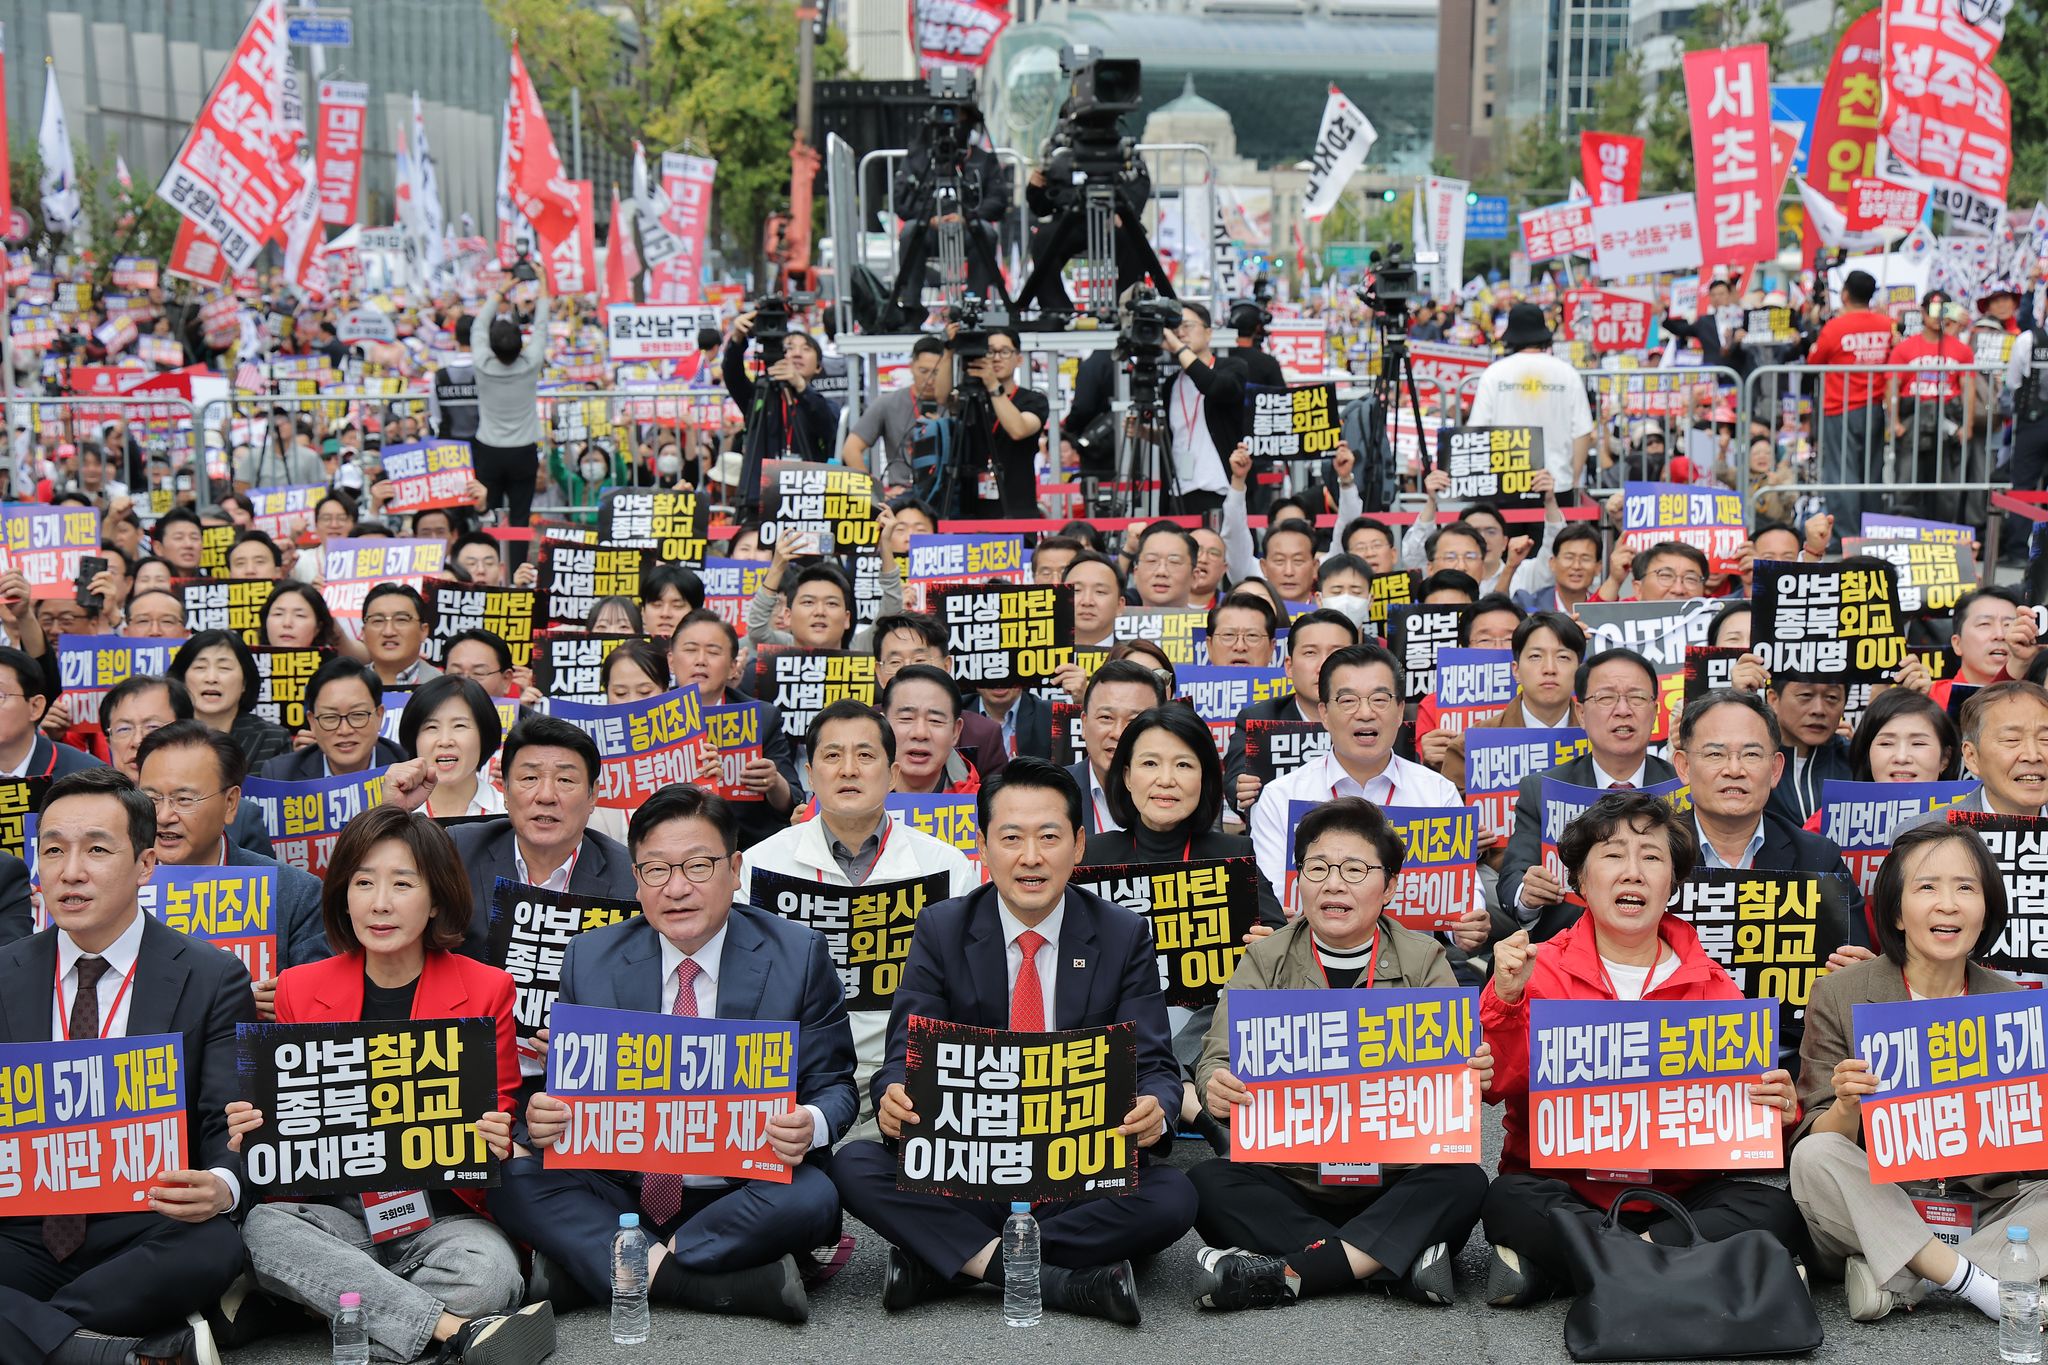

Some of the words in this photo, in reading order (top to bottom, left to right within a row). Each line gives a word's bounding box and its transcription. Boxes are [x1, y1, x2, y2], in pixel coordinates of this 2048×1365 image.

[1706, 61, 1762, 250] 서초갑
[1254, 387, 1329, 415] 안보참사
[1243, 434, 1299, 457] 이재명
[1303, 429, 1342, 454] OUT
[1253, 412, 1330, 437] 종북외교
[1450, 428, 1531, 453] 안보참사
[1450, 451, 1531, 476] 종북외교
[778, 470, 873, 496] 민생파탄
[612, 494, 697, 517] 안보참사
[775, 495, 872, 521] 사법파괴
[1625, 495, 1656, 528] 12개
[1657, 497, 1688, 526] 혐의
[1689, 499, 1715, 525] 5개
[1715, 500, 1744, 526] 재판
[31, 516, 61, 549] 5개
[63, 512, 97, 546] 재판
[611, 516, 693, 539] 종북외교
[836, 521, 880, 545] OUT
[326, 550, 354, 580] 12개
[357, 548, 385, 579] 혐의
[386, 547, 409, 575] 5개
[411, 544, 442, 574] 재판
[553, 548, 642, 575] 민생파탄
[661, 538, 708, 561] OUT
[911, 544, 964, 577] 제멋대로
[966, 539, 1022, 572] 농지조사
[20, 555, 59, 587] 재판
[550, 572, 641, 598] 사법파괴
[1776, 569, 1890, 607] 안보참사
[183, 580, 275, 611] 민생파탄
[436, 588, 536, 617] 민생파탄
[945, 589, 1058, 624] 민생파탄
[947, 617, 1056, 653] 사법파괴
[1405, 613, 1459, 641] 안보
[1774, 602, 1896, 641] 종북외교
[60, 648, 94, 688] 12개
[96, 650, 131, 685] 혐의
[135, 647, 165, 676] 5개
[775, 655, 876, 684] 민생파탄
[948, 650, 1011, 682] 재명
[1016, 646, 1075, 679] OUT
[1755, 639, 1848, 675] 이재명
[1856, 637, 1907, 671] OUT
[1178, 680, 1248, 720] 제멋대로
[1440, 662, 1512, 706] 제멋대로
[628, 690, 702, 752] 농지조사
[1470, 742, 1549, 791] 제멋대로
[282, 790, 325, 836] 혐의
[327, 782, 363, 830] 5개
[164, 874, 271, 936] 농지조사
[777, 883, 928, 930] 안보참사
[1236, 1009, 1351, 1077] 제멋대로
[1357, 997, 1473, 1069] 농지조사
[1536, 1020, 1651, 1086] 제멋대로
[1658, 1006, 1773, 1076] 농지조사
[1859, 1026, 1921, 1094] 12개
[1927, 1015, 1989, 1085] 혐의
[1994, 1005, 2046, 1075] 5개
[273, 1026, 464, 1090] 안보참사
[553, 1032, 608, 1093] 12개
[615, 1035, 671, 1091] 혐의
[679, 1034, 726, 1090] 5개
[733, 1029, 795, 1090] 재판
[934, 1035, 1110, 1091] 민생파탄
[53, 1054, 106, 1122] 5개
[113, 1042, 180, 1113] 재판
[275, 1076, 464, 1138] 종북외교
[933, 1083, 1107, 1140] 사법파괴
[1237, 1081, 1353, 1151] 이나라가
[1358, 1071, 1475, 1140] 북한이냐
[1537, 1089, 1652, 1157] 이나라가
[1871, 1091, 1969, 1170] 이재명
[1974, 1080, 2044, 1149] 재판
[555, 1097, 646, 1157] 이재명
[654, 1097, 719, 1154] 재판
[31, 1127, 102, 1193] 재판
[111, 1117, 179, 1184] 재개
[246, 1131, 387, 1186] 이재명
[400, 1124, 488, 1171] OUT
[754, 1160, 785, 1173] 국민의힘
[904, 1135, 1033, 1185] 이재명
[1046, 1128, 1127, 1183] OUT
[1442, 1143, 1473, 1154] 국민의힘
[1743, 1149, 1774, 1160] 국민의힘
[456, 1170, 488, 1181] 국민의힘
[1096, 1179, 1127, 1190] 국민의힘
[378, 1202, 416, 1221] 국회의원
